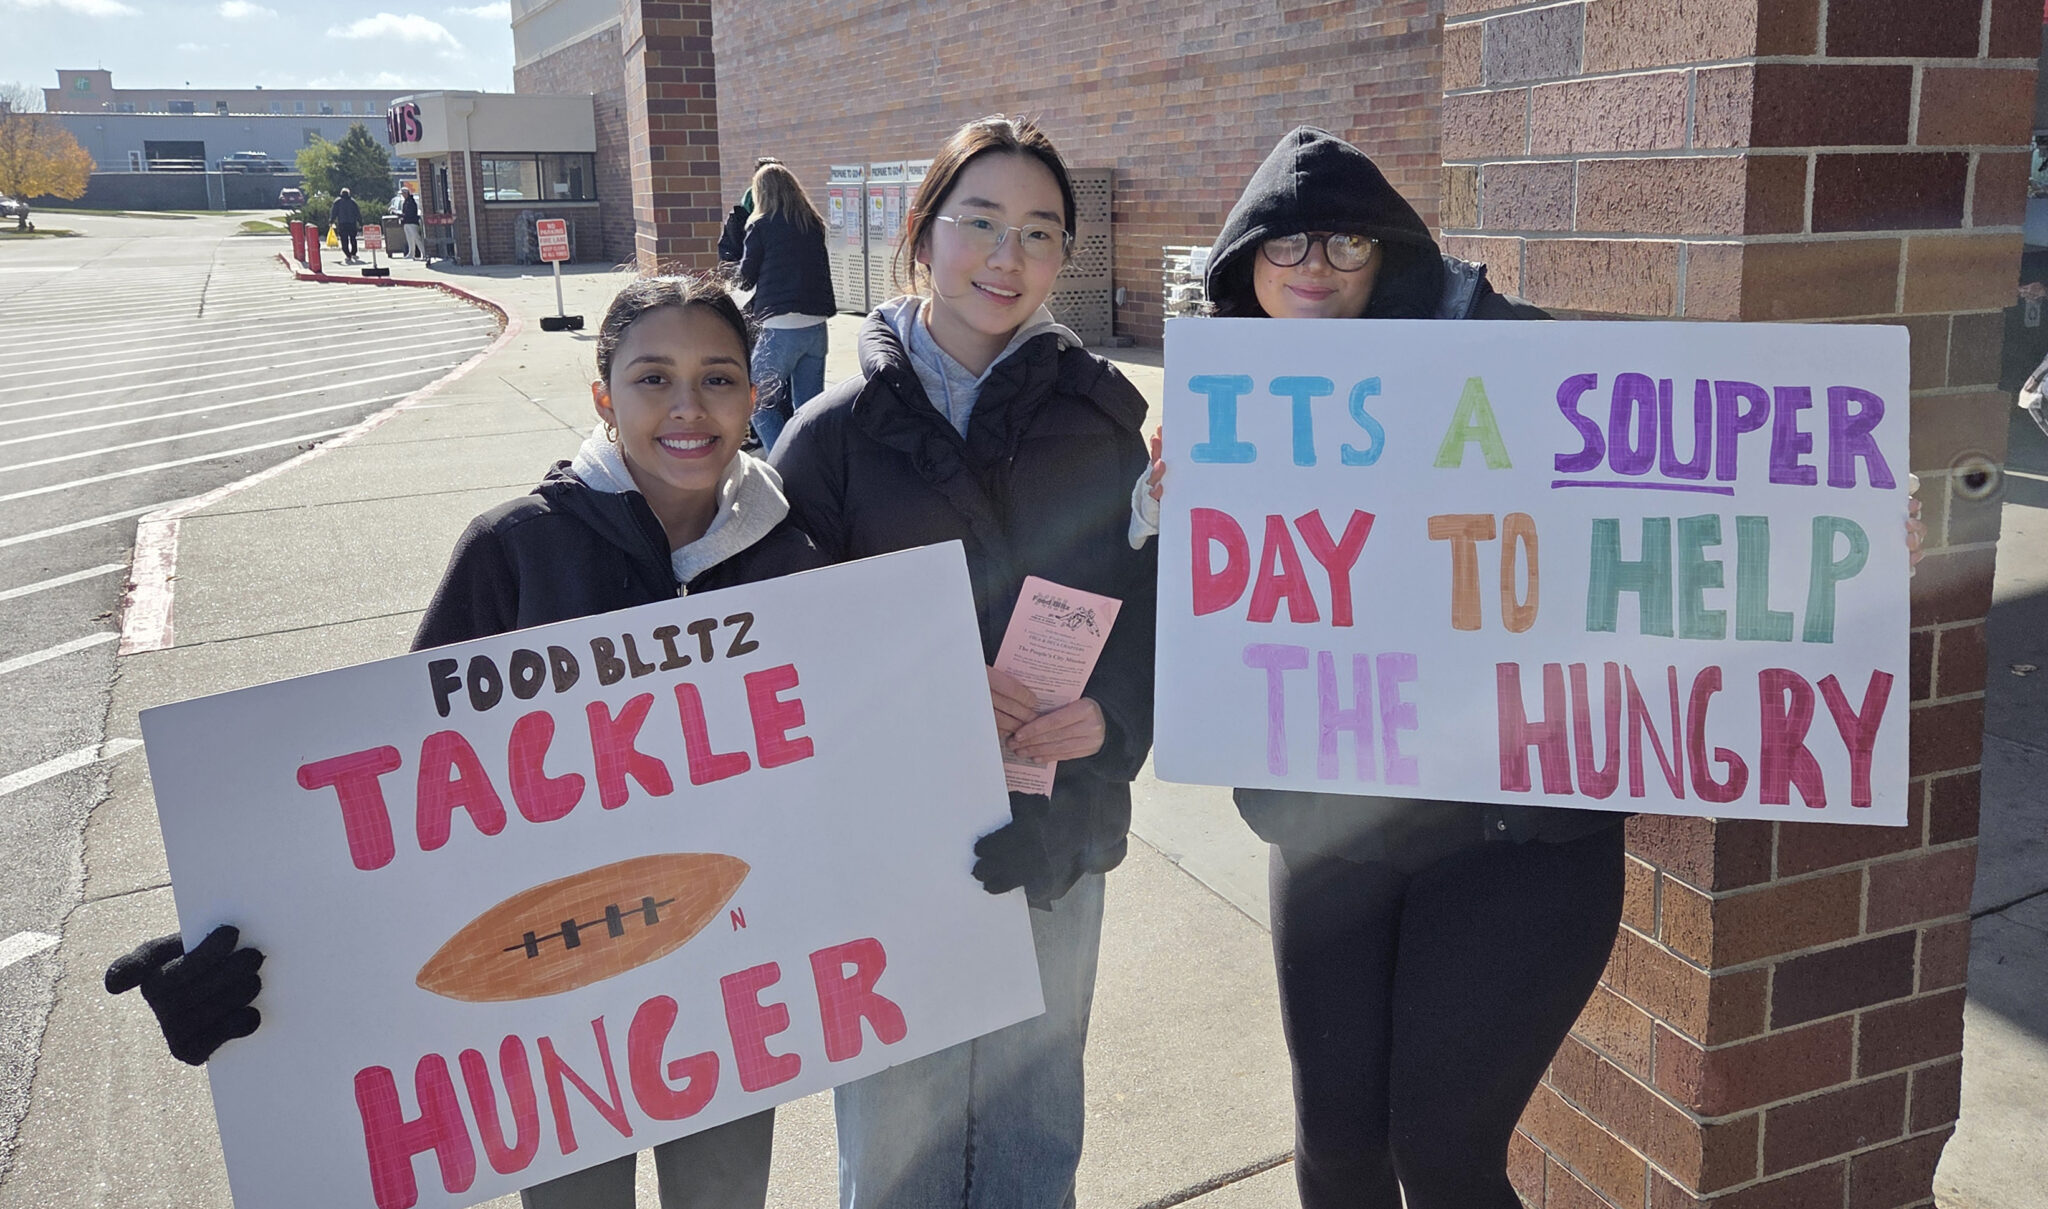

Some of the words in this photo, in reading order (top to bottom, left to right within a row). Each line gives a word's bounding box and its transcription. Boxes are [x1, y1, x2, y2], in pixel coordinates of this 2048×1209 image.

[831, 169, 847, 178] PROPANE
[872, 167, 887, 177] PROPANE
[1188, 374, 1386, 467] ITS
[1433, 376, 1513, 470] A
[1554, 371, 1897, 490] SOUPER
[1189, 507, 1376, 628] DAY
[1427, 511, 1540, 634] TO
[1586, 513, 1870, 644] HELP
[428, 645, 581, 718] FOOD
[590, 611, 760, 687] BLITZ
[296, 663, 815, 872] TACKLE
[1242, 643, 1420, 786] THE
[1495, 661, 1894, 809] HUNGRY
[730, 907, 747, 932] N
[353, 936, 908, 1209] HUNGER
